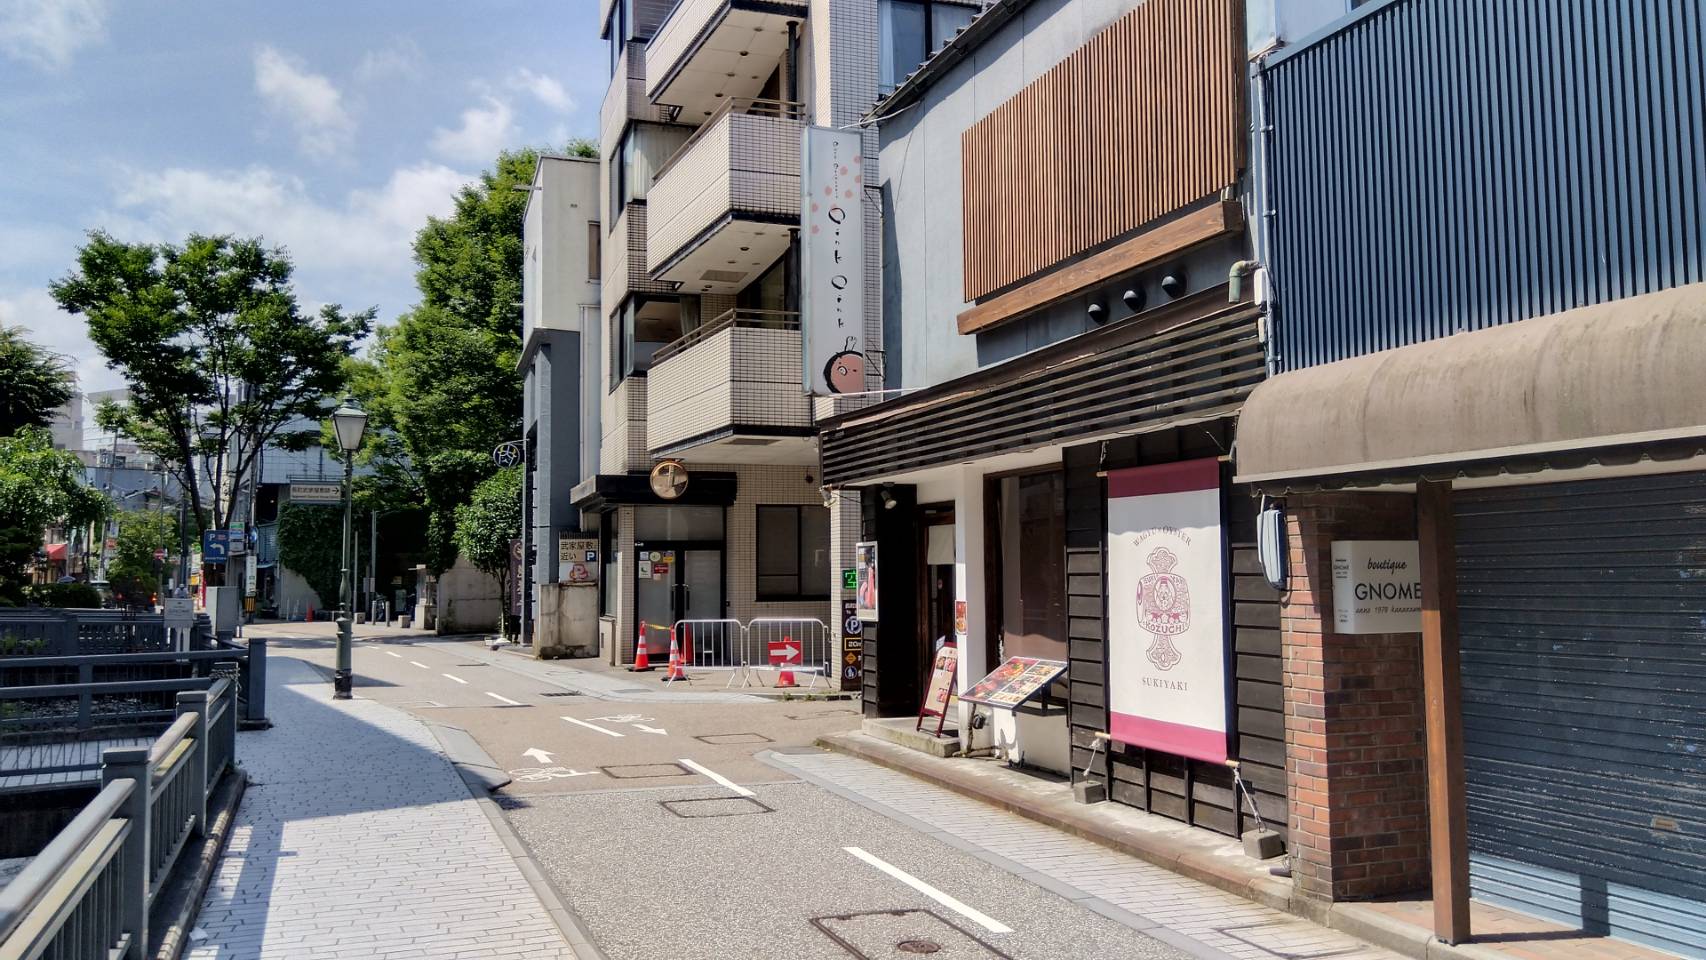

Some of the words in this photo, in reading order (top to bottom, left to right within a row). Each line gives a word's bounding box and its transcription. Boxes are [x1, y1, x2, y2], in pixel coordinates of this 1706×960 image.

[586, 551, 596, 561] P
[1367, 557, 1408, 575] boutique
[1355, 582, 1422, 601] GNOME
[1145, 620, 1185, 634] KOZUCHI
[1142, 677, 1188, 691] SUKIYAKI
